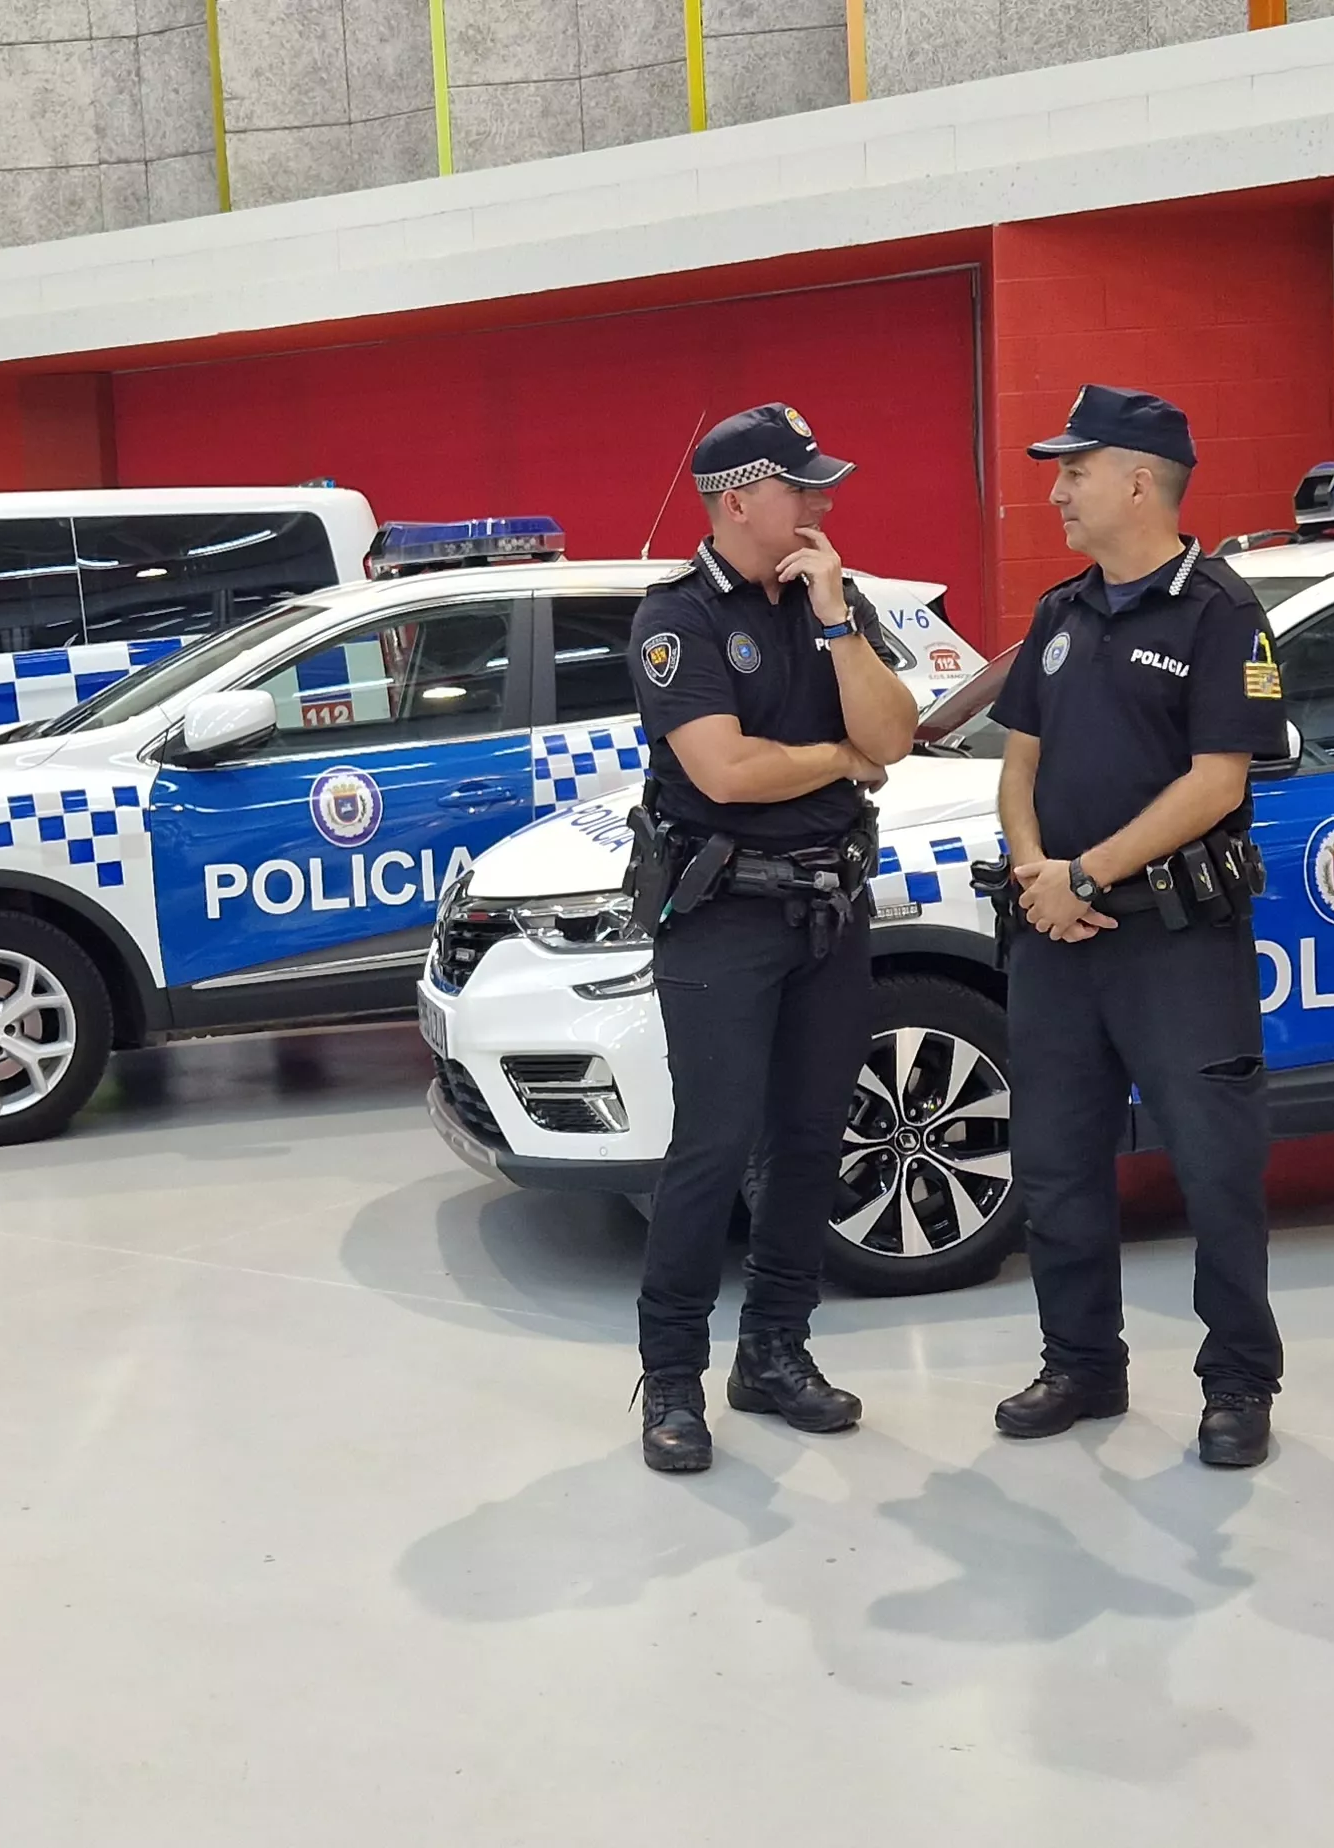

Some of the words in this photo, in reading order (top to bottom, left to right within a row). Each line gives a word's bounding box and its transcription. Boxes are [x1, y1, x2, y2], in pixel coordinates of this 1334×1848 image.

[889, 609, 930, 630] V-6
[937, 656, 956, 671] 112
[1130, 649, 1190, 678] POLICIA
[307, 705, 349, 727] 112
[204, 846, 475, 919] POLICIA
